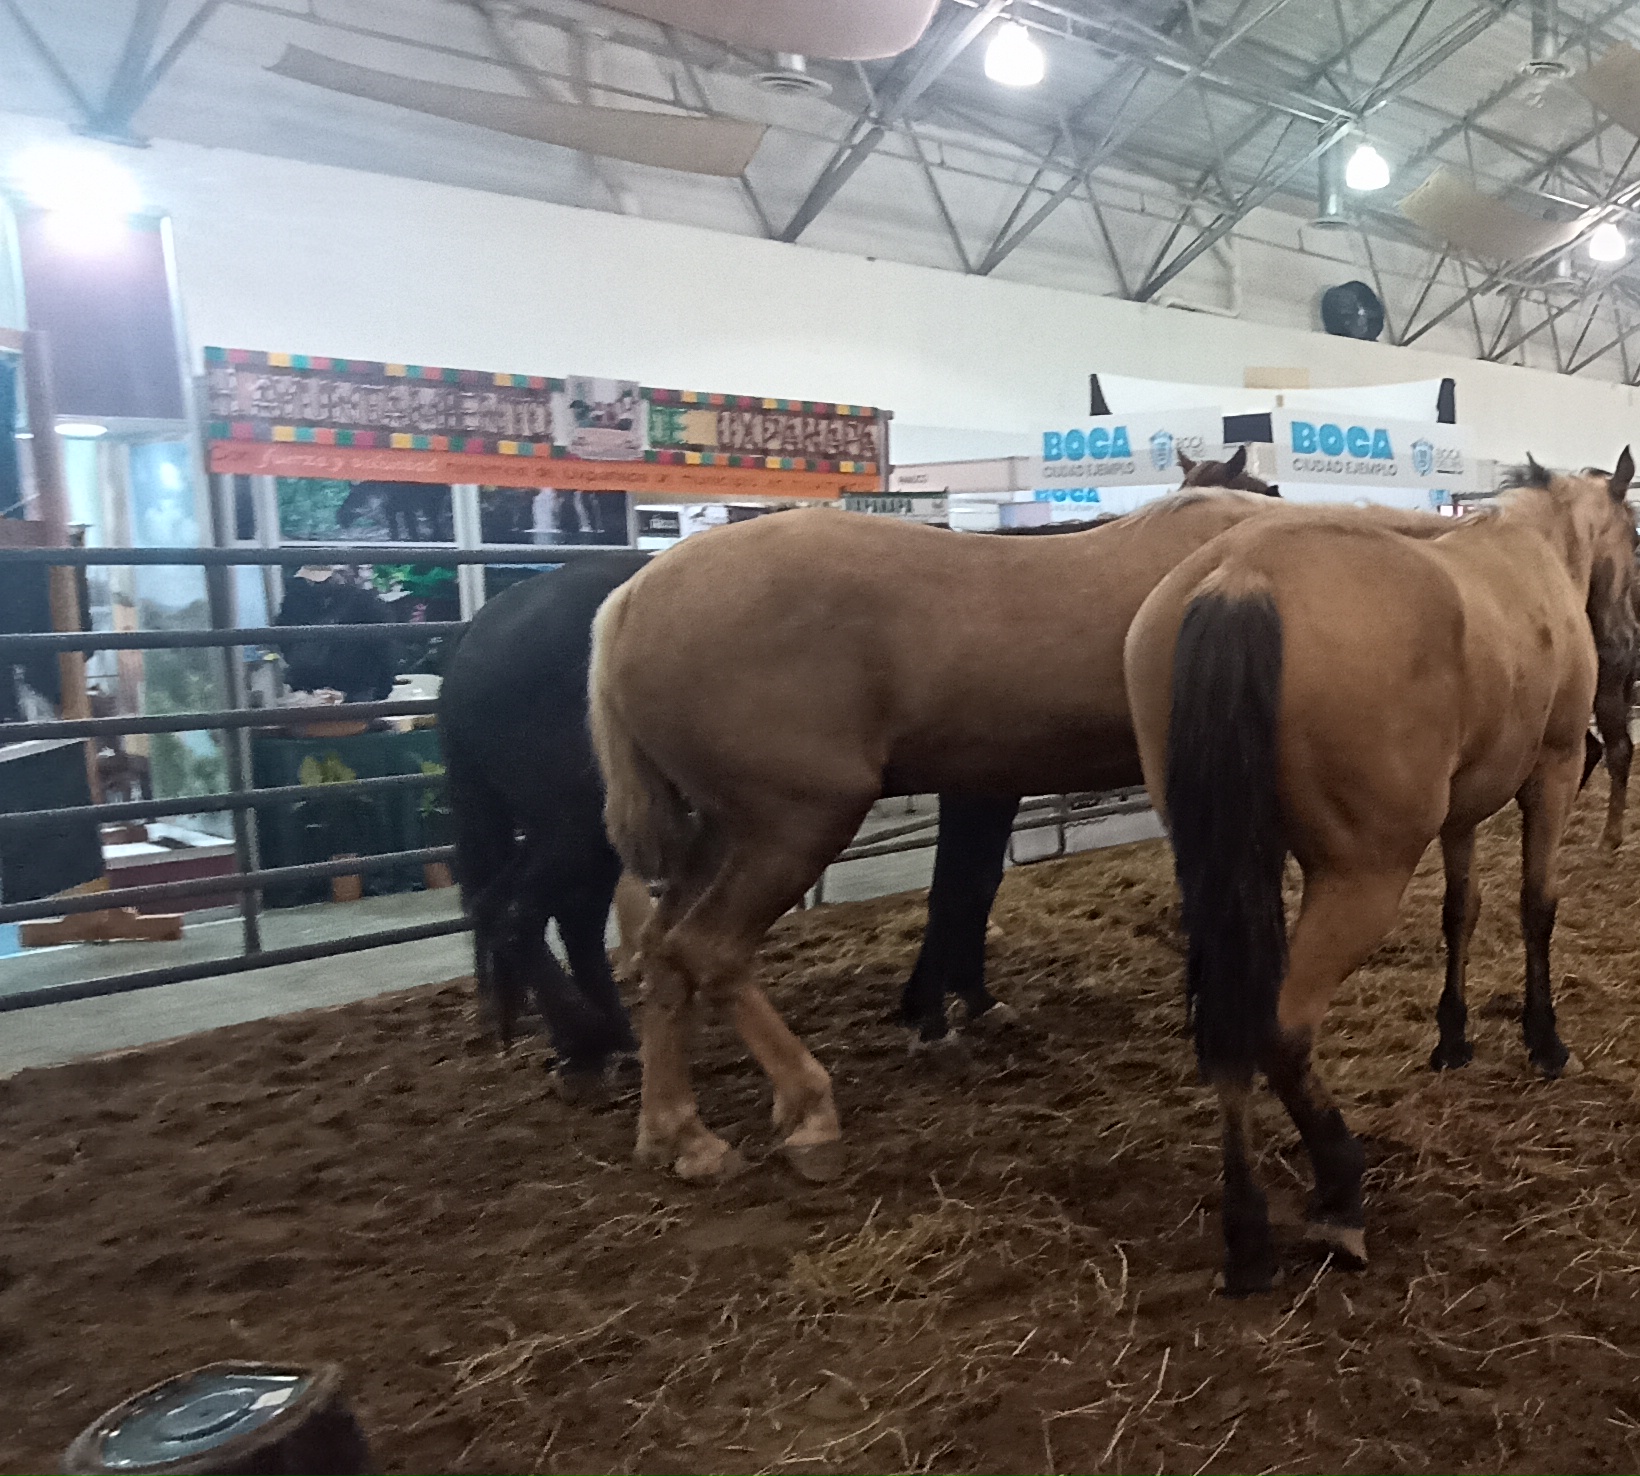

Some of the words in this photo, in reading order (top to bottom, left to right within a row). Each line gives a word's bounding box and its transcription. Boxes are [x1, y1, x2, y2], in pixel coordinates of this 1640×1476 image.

[1043, 426, 1132, 461] BOCA
[1291, 420, 1394, 460] BOCA
[1293, 458, 1342, 474] CIUDAD
[1346, 462, 1398, 477] EJEMPLO
[1034, 488, 1100, 503] BOCA
